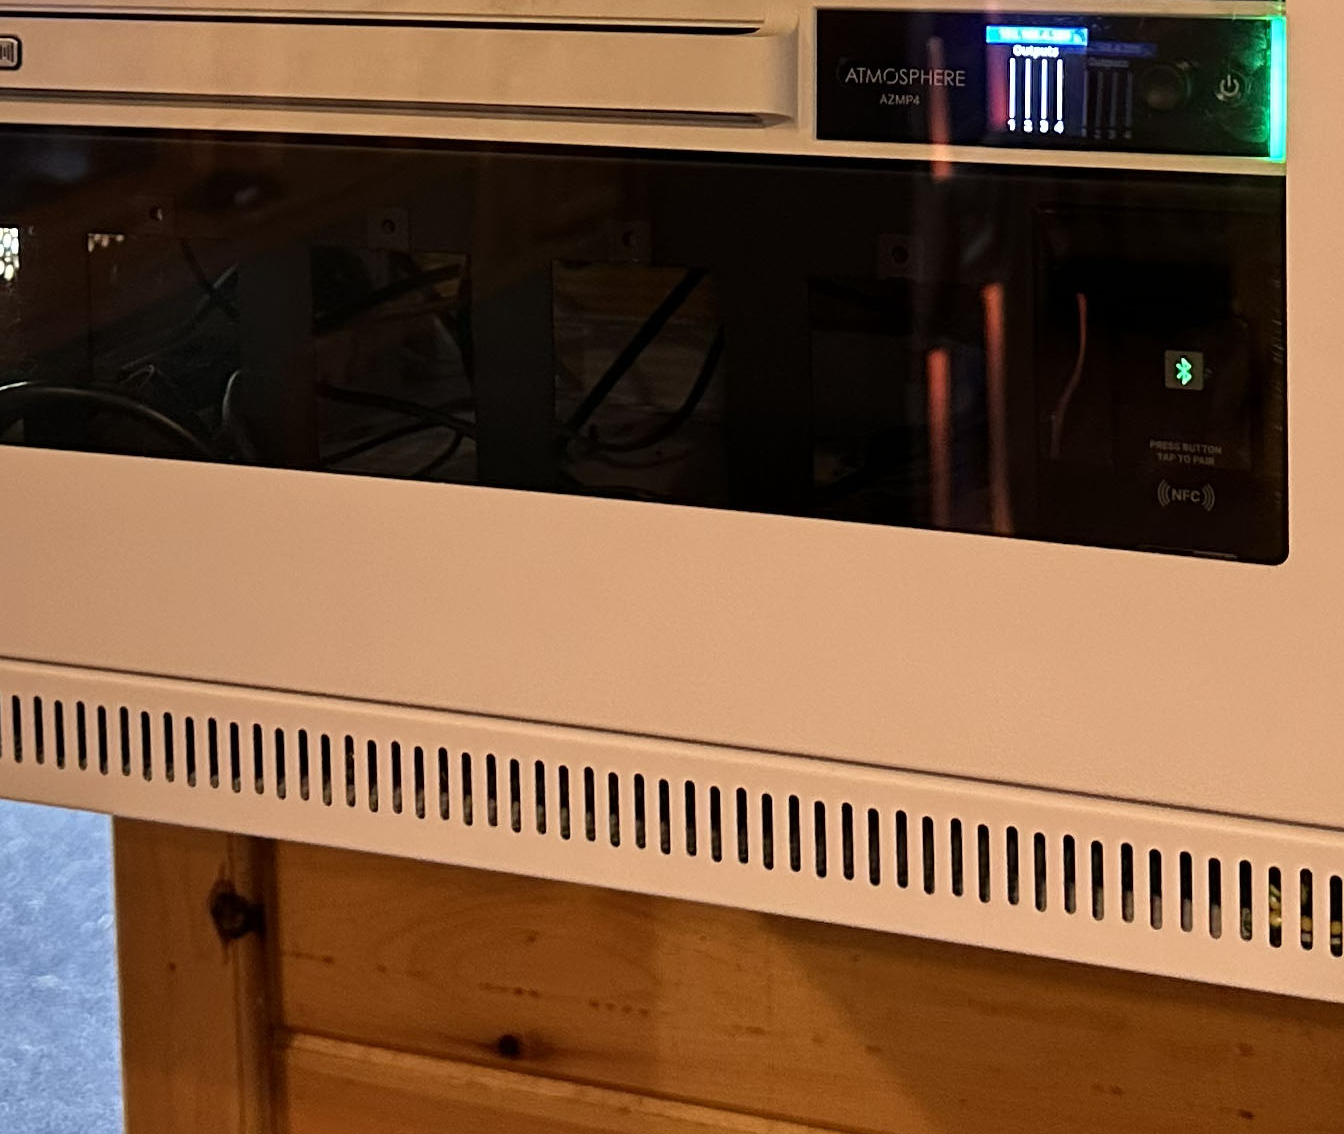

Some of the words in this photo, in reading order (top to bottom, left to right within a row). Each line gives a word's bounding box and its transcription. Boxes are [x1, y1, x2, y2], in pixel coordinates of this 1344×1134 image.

[844, 67, 966, 87] ATMOSPHERE
[879, 93, 921, 106] AZMP4
[1007, 118, 1016, 131] 1
[1182, 443, 1222, 455] BUTTON
[1171, 488, 1201, 503] NFC
